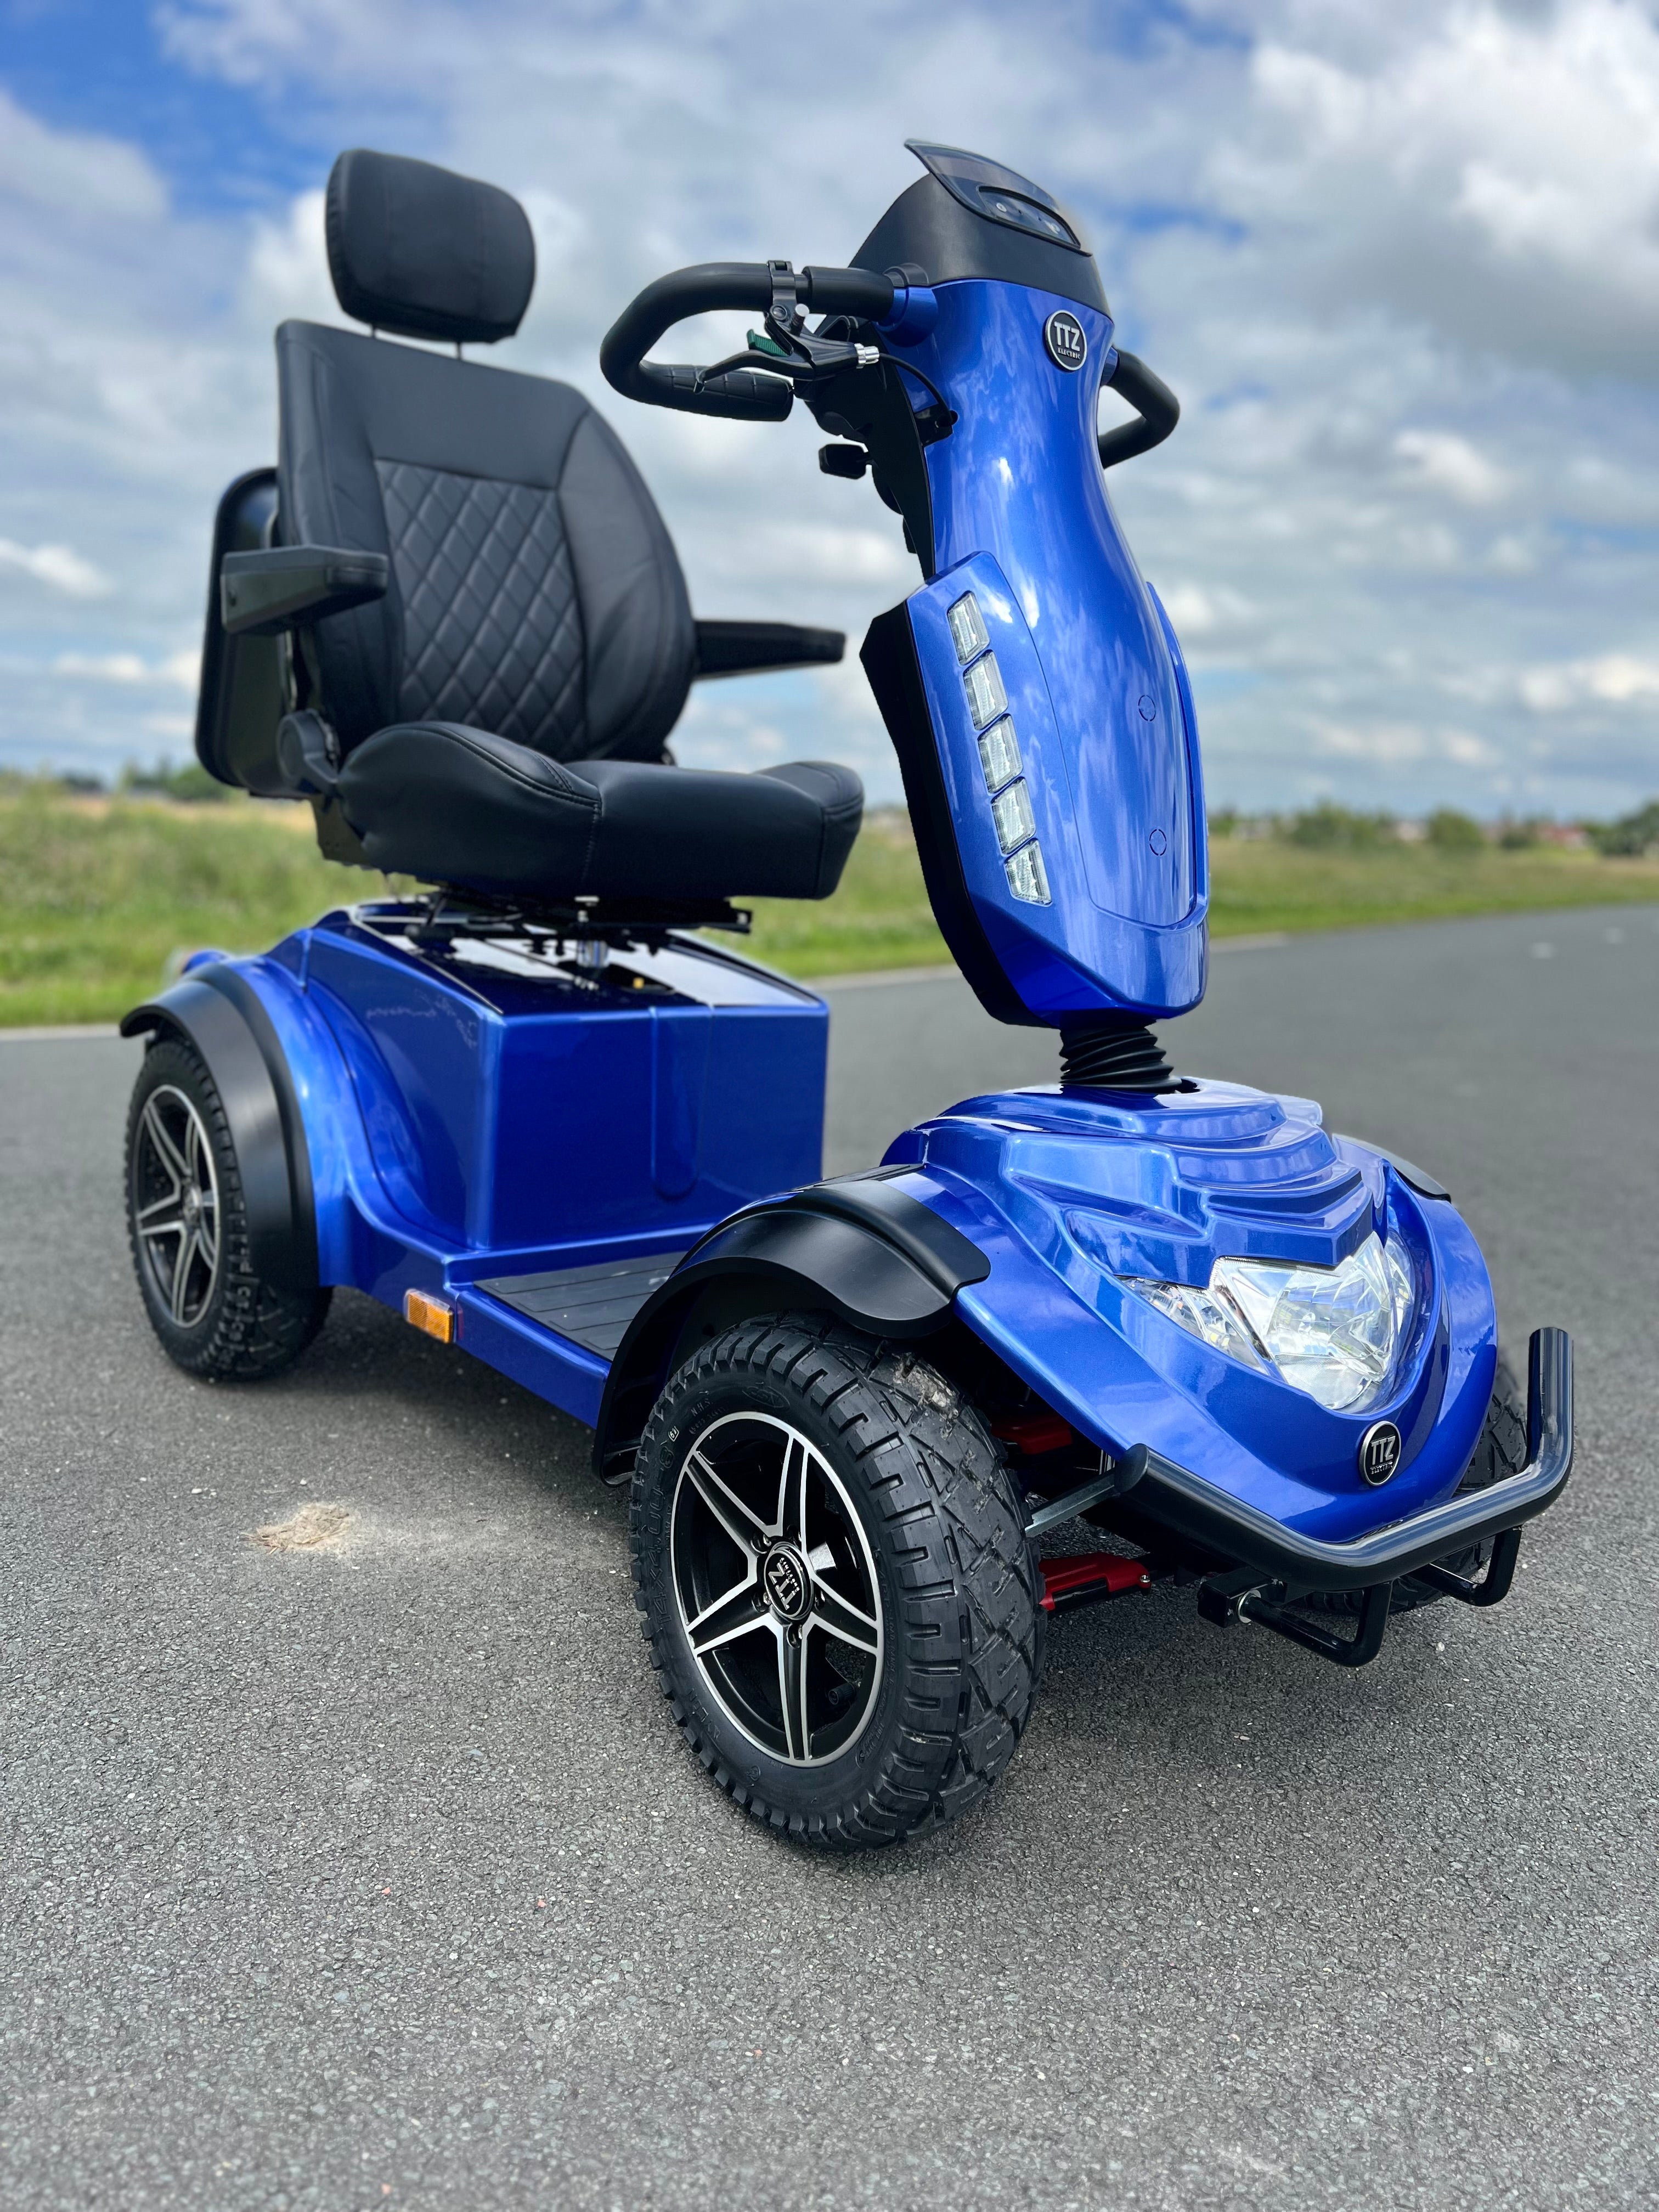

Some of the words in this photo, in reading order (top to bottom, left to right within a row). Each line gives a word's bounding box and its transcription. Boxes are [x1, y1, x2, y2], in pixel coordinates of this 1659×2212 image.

[1054, 321, 1080, 352] TTZ
[1058, 347, 1081, 360] ELECTRIC
[1370, 1435, 1396, 1466] TTZ
[768, 1562, 797, 1611] TTZ
